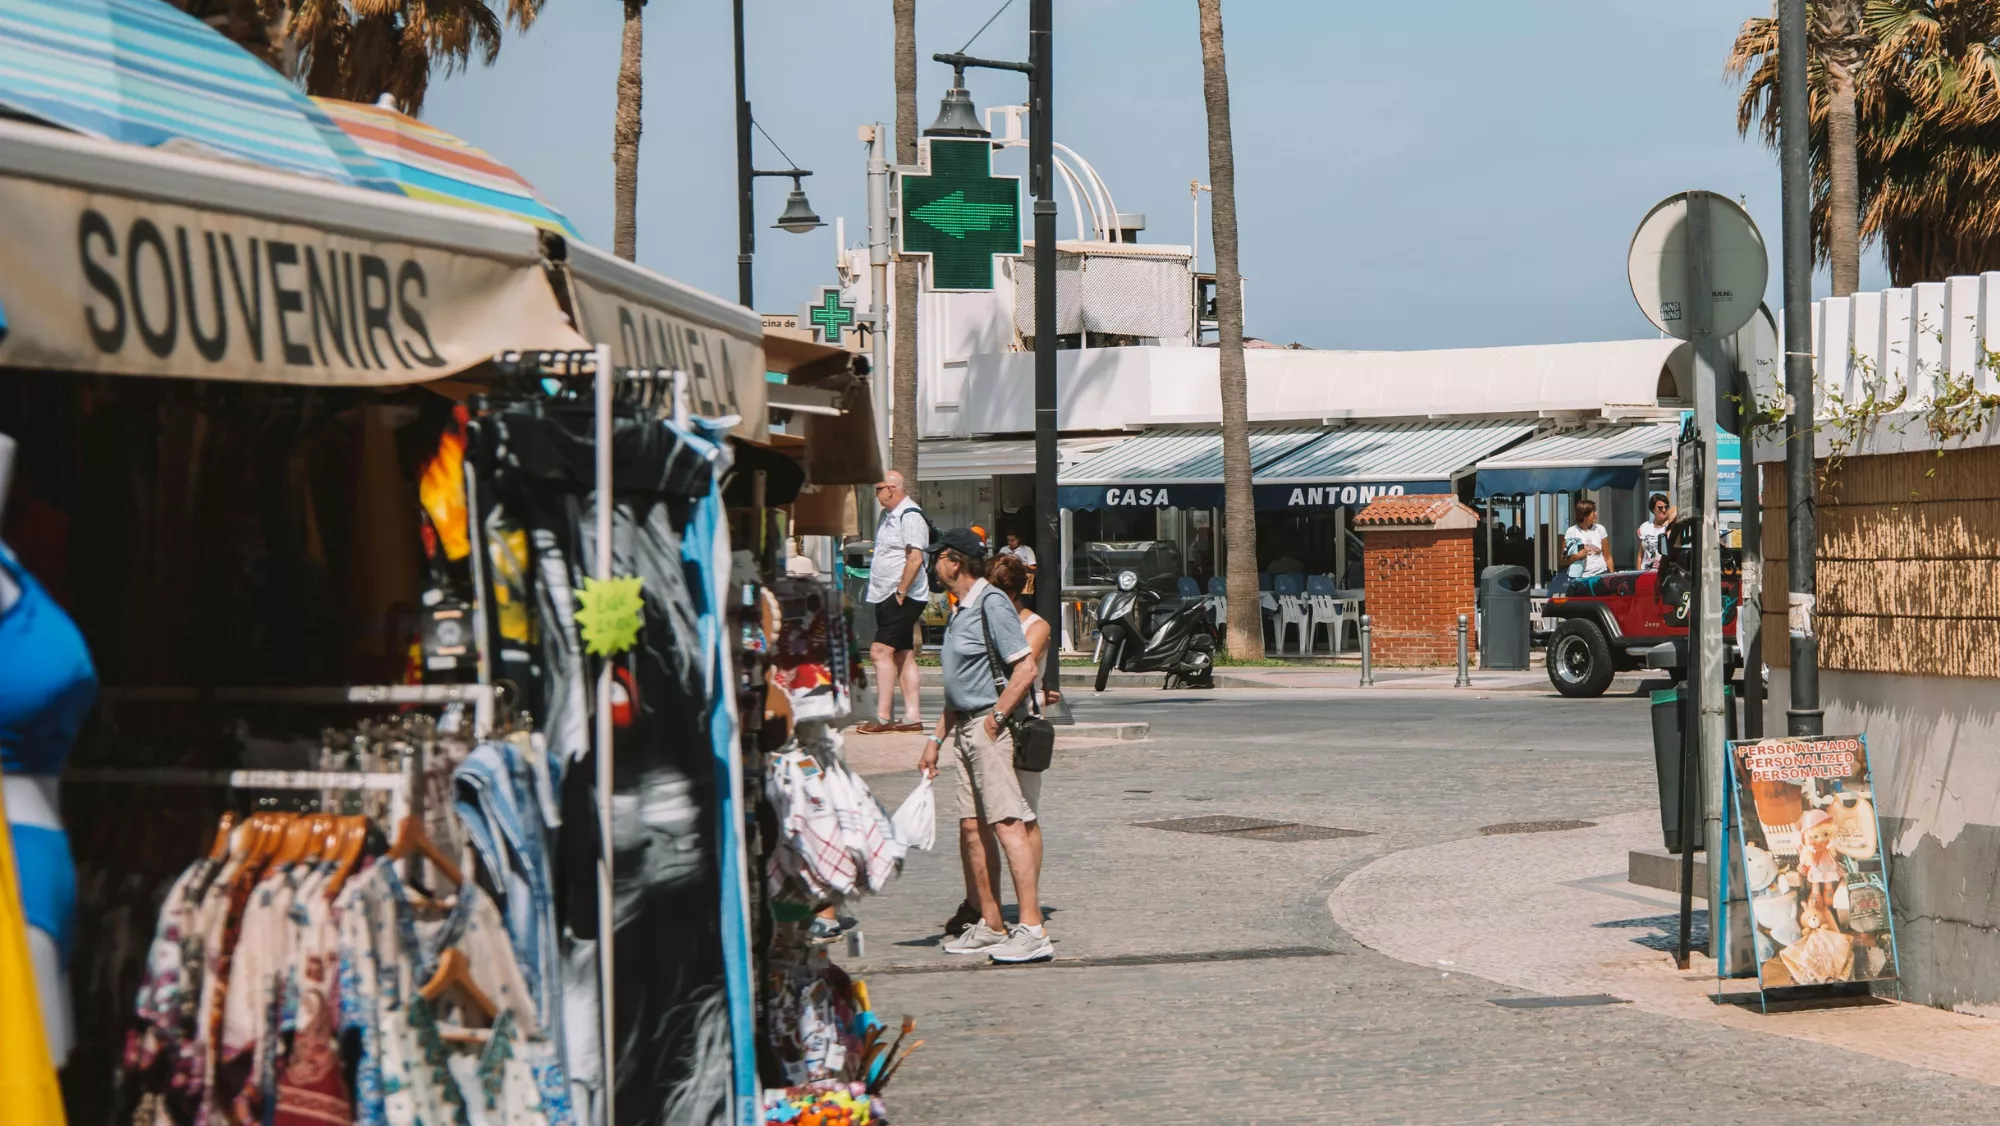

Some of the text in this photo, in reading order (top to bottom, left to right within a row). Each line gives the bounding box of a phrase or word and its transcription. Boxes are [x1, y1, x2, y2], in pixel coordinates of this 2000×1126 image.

[79, 209, 447, 370] SOUVENIRS
[761, 319, 796, 328] cina de
[1106, 485, 1405, 506] CASA ANTONIO
[1738, 740, 1858, 757] PERSONALIZADO
[1746, 752, 1854, 769] PERSONALIZED
[1752, 765, 1851, 782] PERSONALISE
